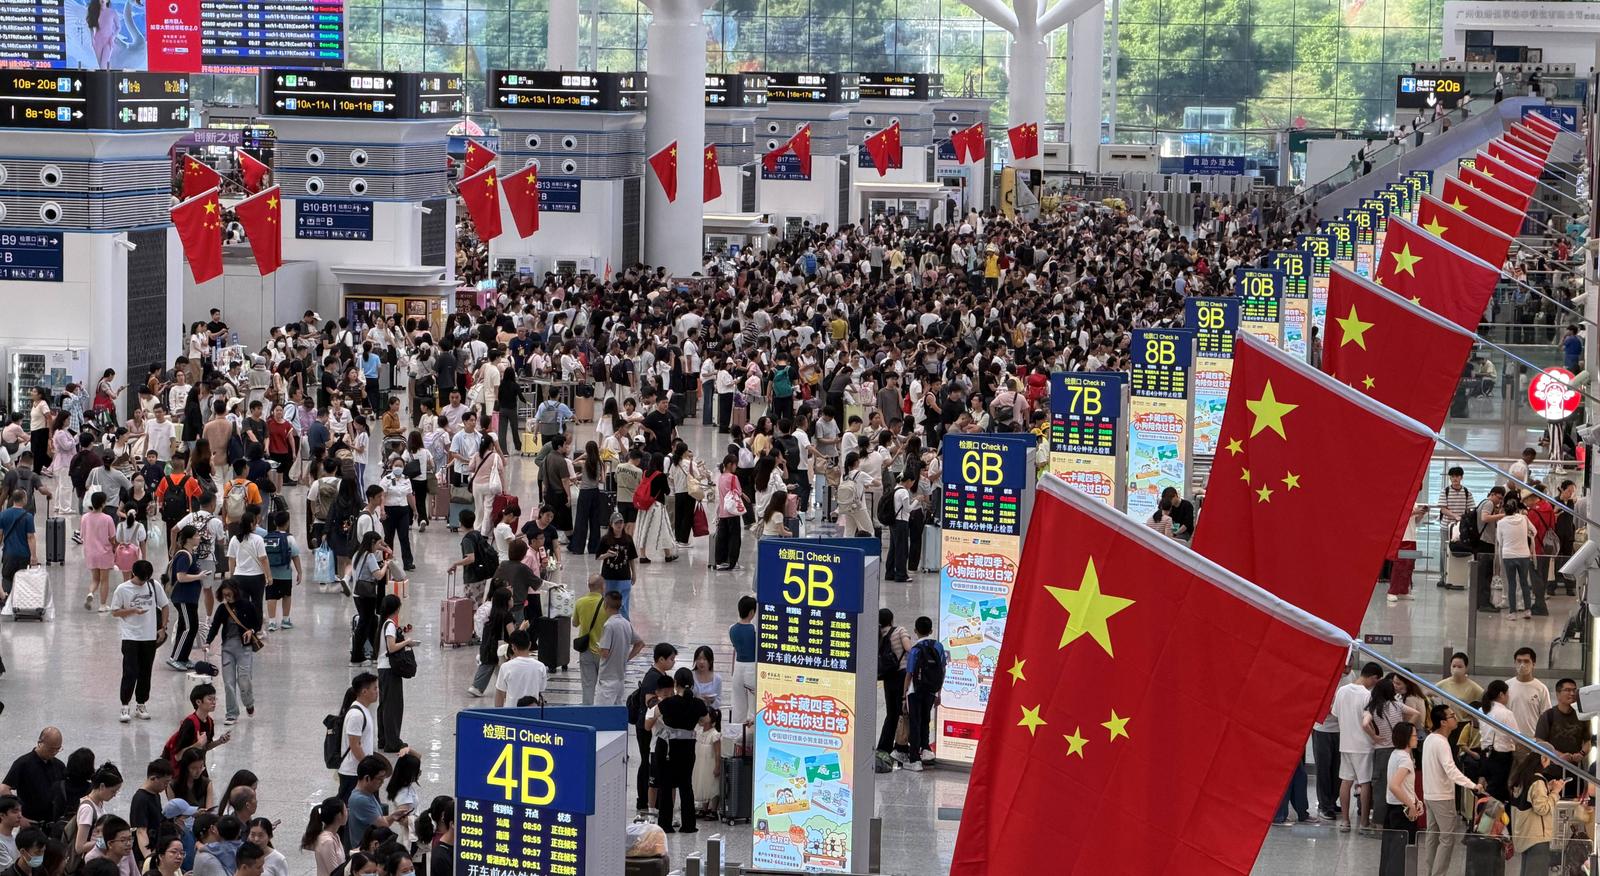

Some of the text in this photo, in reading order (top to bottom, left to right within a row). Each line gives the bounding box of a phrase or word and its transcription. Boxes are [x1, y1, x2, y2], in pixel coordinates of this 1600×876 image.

[1436, 80, 1460, 92] 20B
[297, 100, 330, 110] 10A-11A
[340, 100, 372, 111] 10B-11B
[194, 131, 240, 144] 创新之城
[1193, 158, 1235, 166] 自助办理处
[326, 218, 333, 226] B
[5, 252, 13, 262] B
[1302, 242, 1329, 257] 12B
[1273, 258, 1303, 275] 11B
[1241, 277, 1274, 296] 10B
[1198, 307, 1225, 328] 9B
[1145, 340, 1176, 364] 8B
[1068, 386, 1102, 415] 7B
[959, 440, 979, 450] 检票口
[981, 442, 1001, 451] Check
[1056, 444, 1110, 454] 开车前4分钟停止检票
[962, 450, 1004, 486] 6B
[949, 520, 1013, 533] 开车前4分钟停止检票
[779, 548, 840, 563] 检票口 Check in
[956, 554, 1003, 568] 一卡藏四季
[948, 566, 1014, 581] 小狗陪你过日常
[782, 562, 835, 607] 5B
[830, 621, 851, 629] 正在候车
[830, 631, 851, 639] 正在候车
[830, 640, 850, 648] 正在候车
[766, 651, 848, 670] 开车前4分钟停止检票
[830, 650, 850, 658] 正在候车
[774, 696, 834, 714] 一卡藏四季
[765, 710, 848, 732] 小狗陪你过日常
[483, 723, 563, 746] 检票口 Check in
[486, 744, 556, 806] 4B
[465, 800, 572, 823] 车次 终到站 开点 状态
[461, 813, 483, 823] D7318
[522, 822, 542, 831] 08:50
[551, 825, 578, 837] 正在候车
[461, 826, 483, 836] D2290
[522, 835, 541, 844] 08:55
[551, 838, 578, 850] 正在候车
[496, 843, 509, 854] 汕头
[522, 847, 541, 857] 09:37
[550, 851, 577, 863] 正在候车
[460, 852, 482, 862] G6579
[486, 854, 519, 868] 香港西九龙
[522, 860, 540, 870] 09:51
[550, 864, 577, 876] 正在候车
